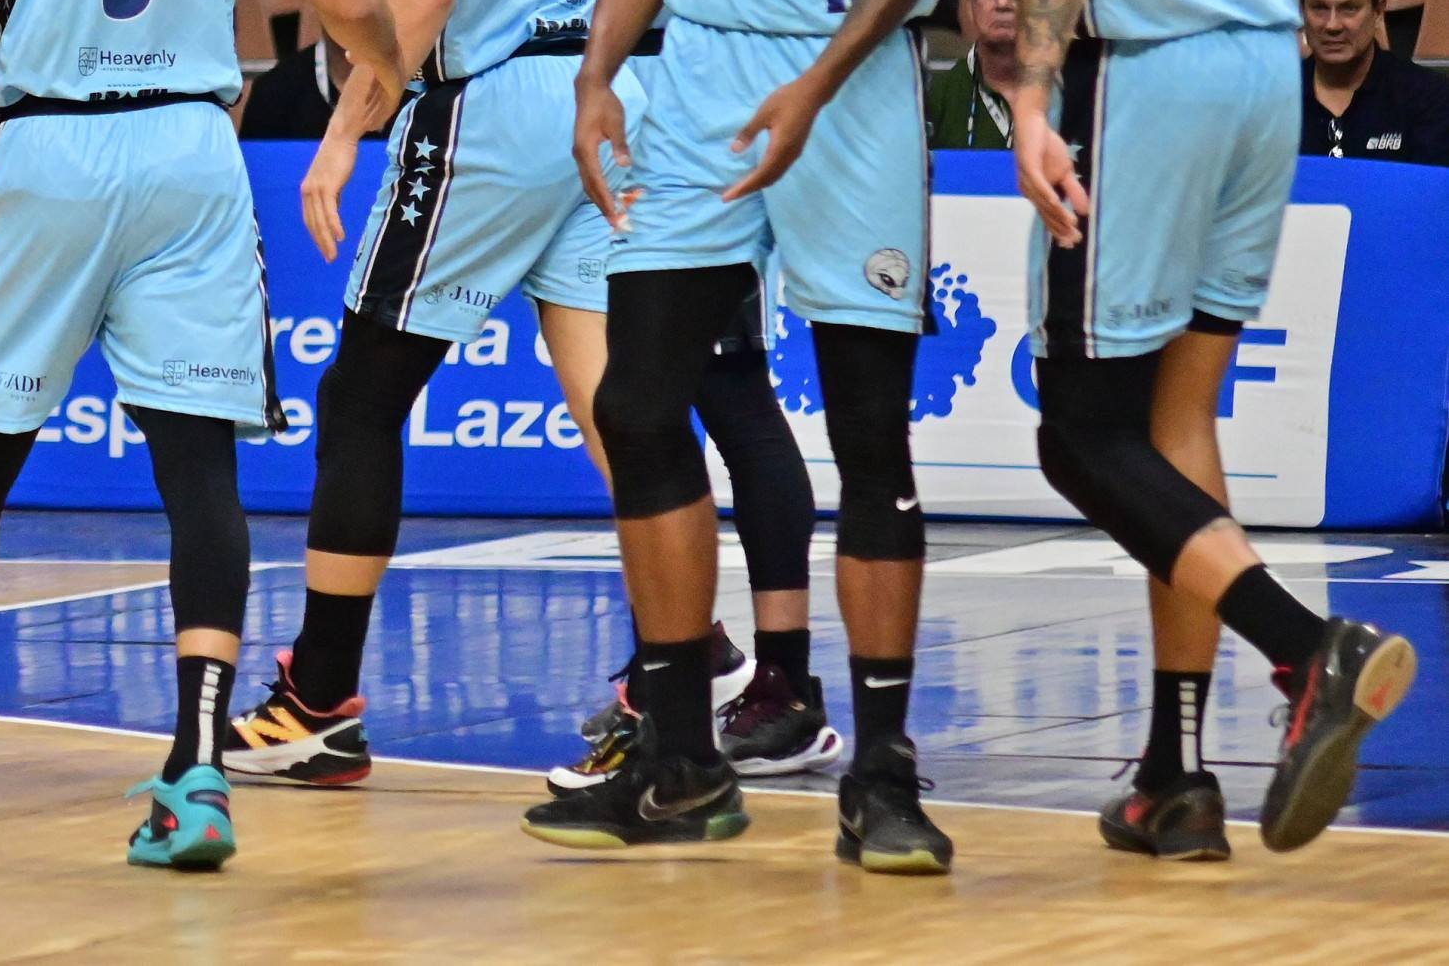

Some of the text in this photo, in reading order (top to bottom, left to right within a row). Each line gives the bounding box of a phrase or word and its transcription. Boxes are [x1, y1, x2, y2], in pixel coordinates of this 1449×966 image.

[99, 49, 177, 67] Heavenly
[188, 362, 257, 385] Heavenly
[408, 383, 585, 450] Laze
